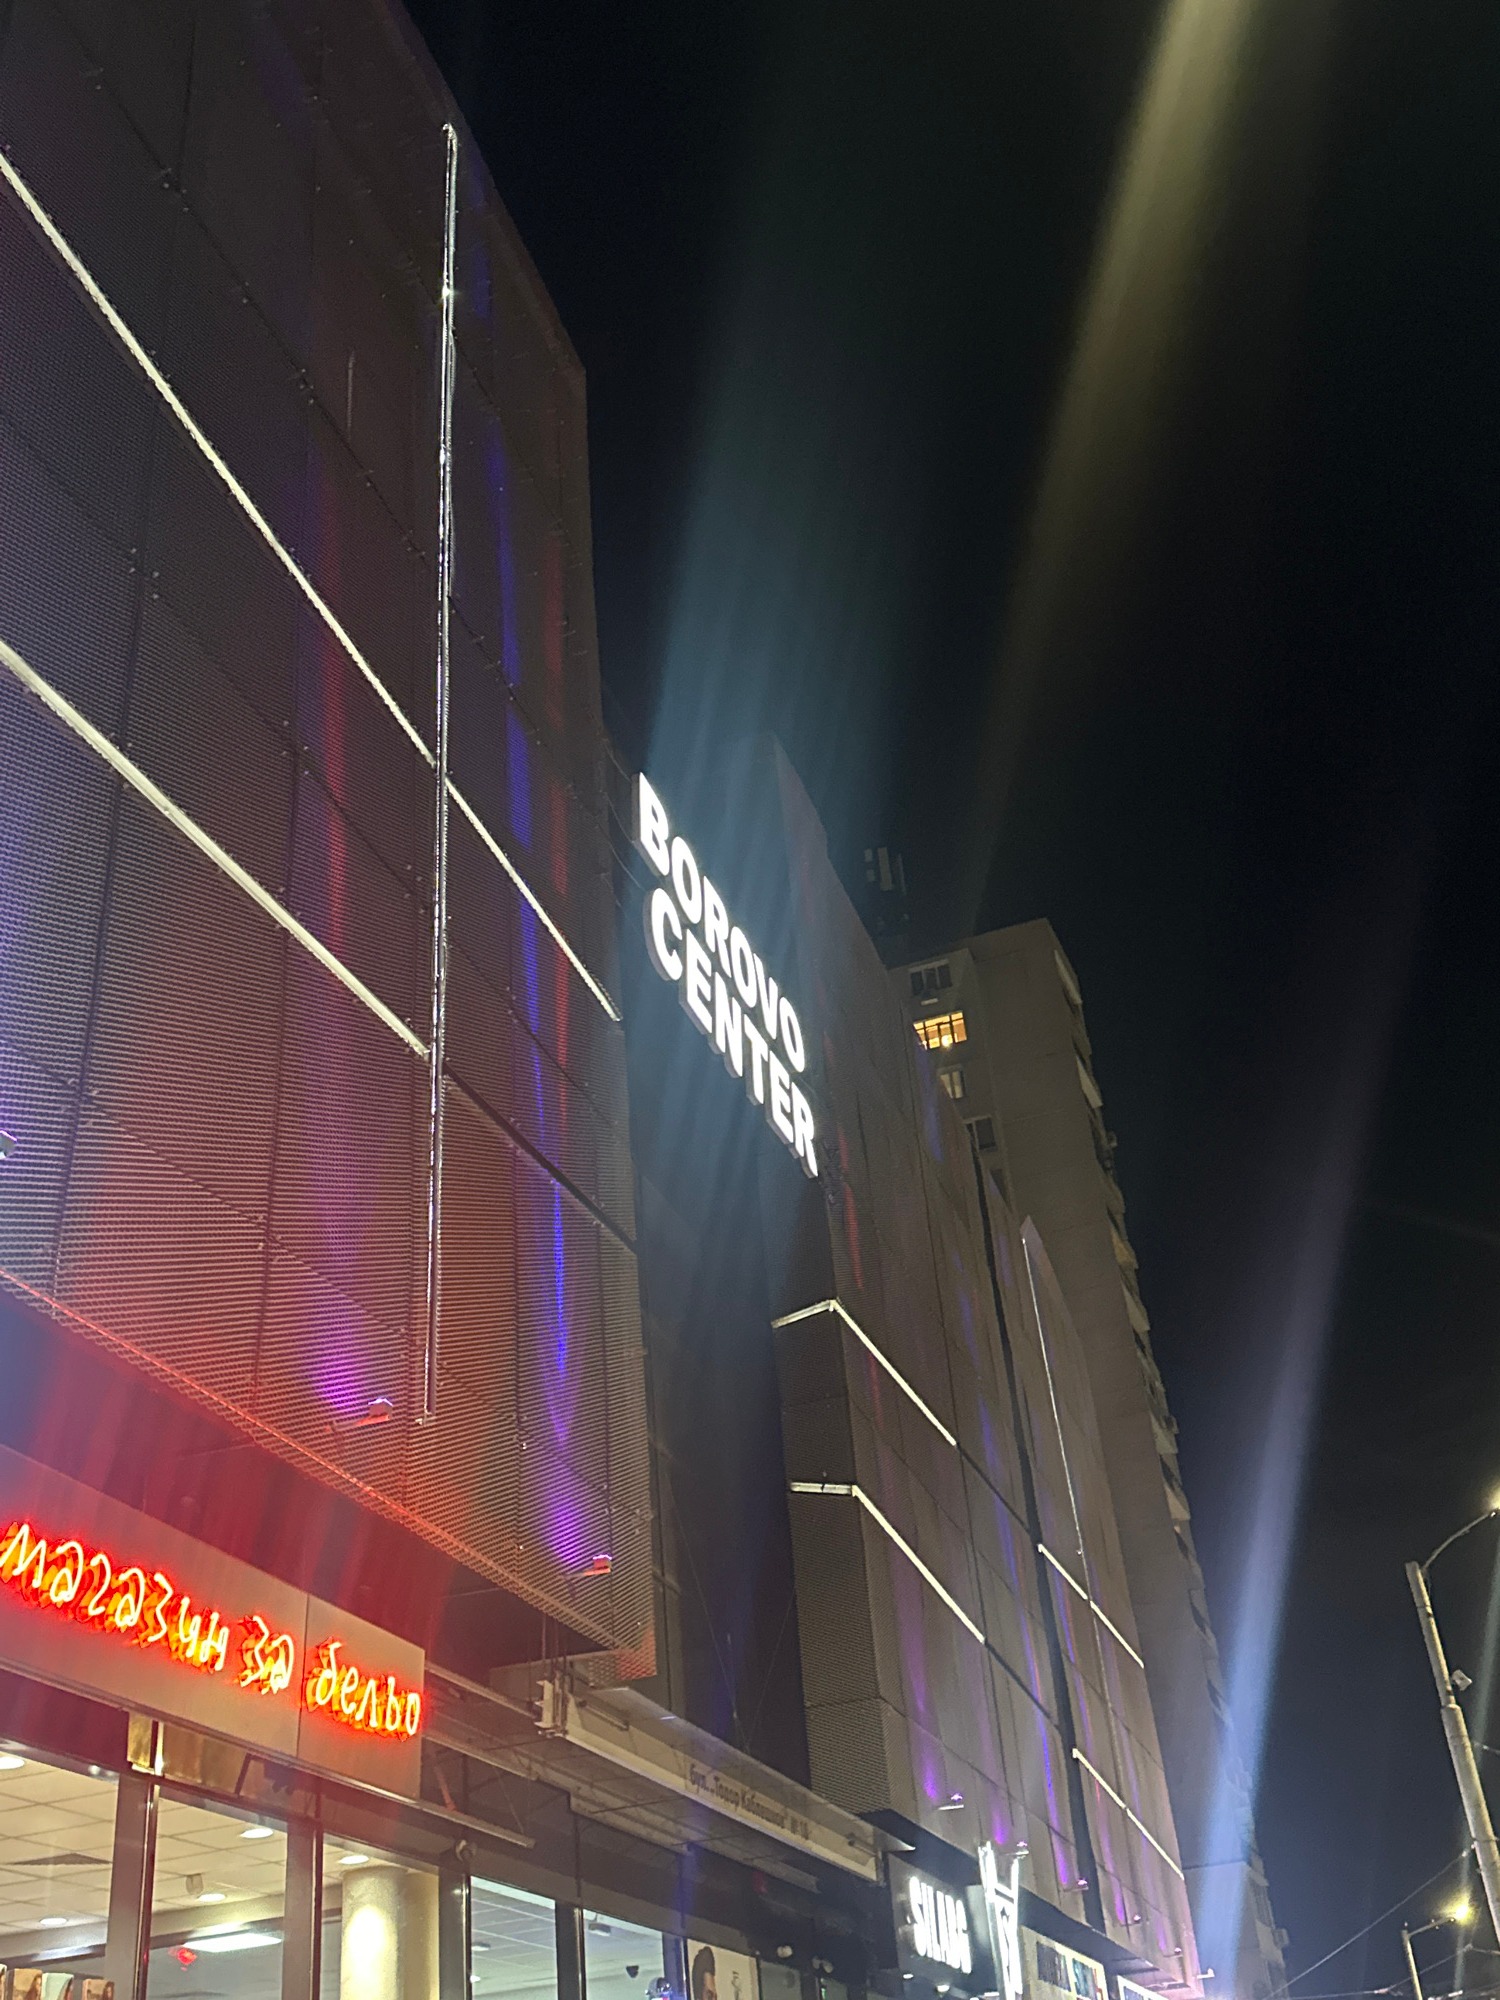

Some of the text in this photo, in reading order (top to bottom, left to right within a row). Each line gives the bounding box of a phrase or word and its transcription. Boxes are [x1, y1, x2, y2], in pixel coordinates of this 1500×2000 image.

[639, 772, 805, 1072] BOROVO
[650, 887, 818, 1177] CENTER
[240, 1616, 294, 1693] за
[313, 1642, 421, 1736] бельо
